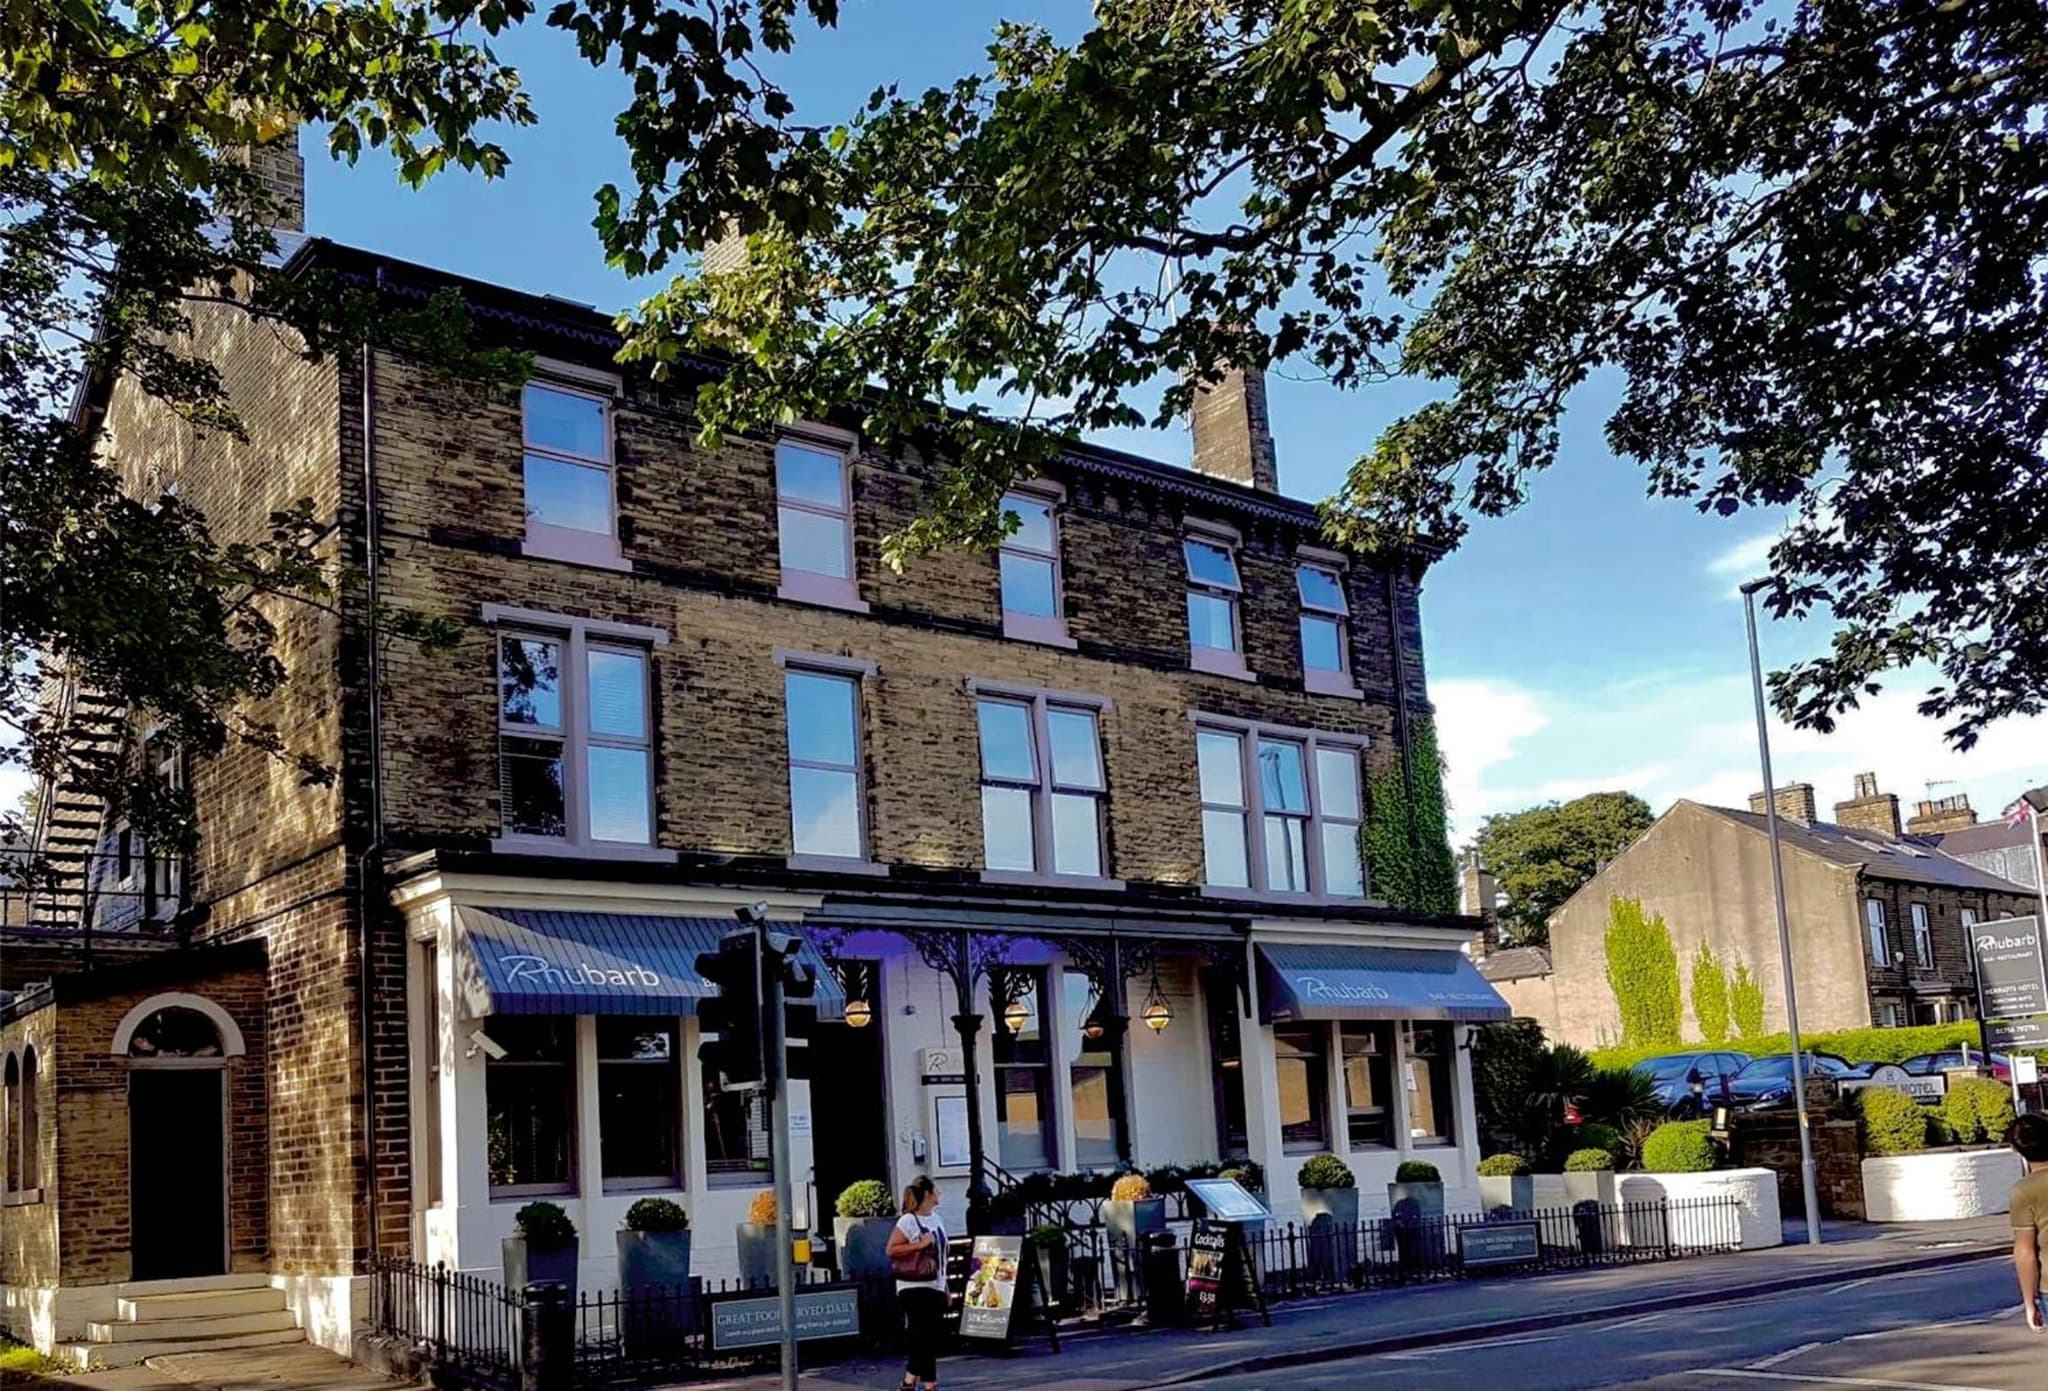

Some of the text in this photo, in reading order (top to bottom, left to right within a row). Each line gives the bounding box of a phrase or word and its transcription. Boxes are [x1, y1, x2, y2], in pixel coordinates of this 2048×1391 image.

[1976, 934, 2036, 953] Rhubarb
[499, 954, 660, 987] Rhubarb
[1297, 976, 1389, 1000] Rhubarb
[1901, 1082, 1937, 1095] HOTEL
[1194, 1233, 1225, 1250] Cocktails
[717, 1310, 752, 1326] GREAT
[755, 1309, 781, 1323] FOO
[826, 1302, 857, 1315] DAILY
